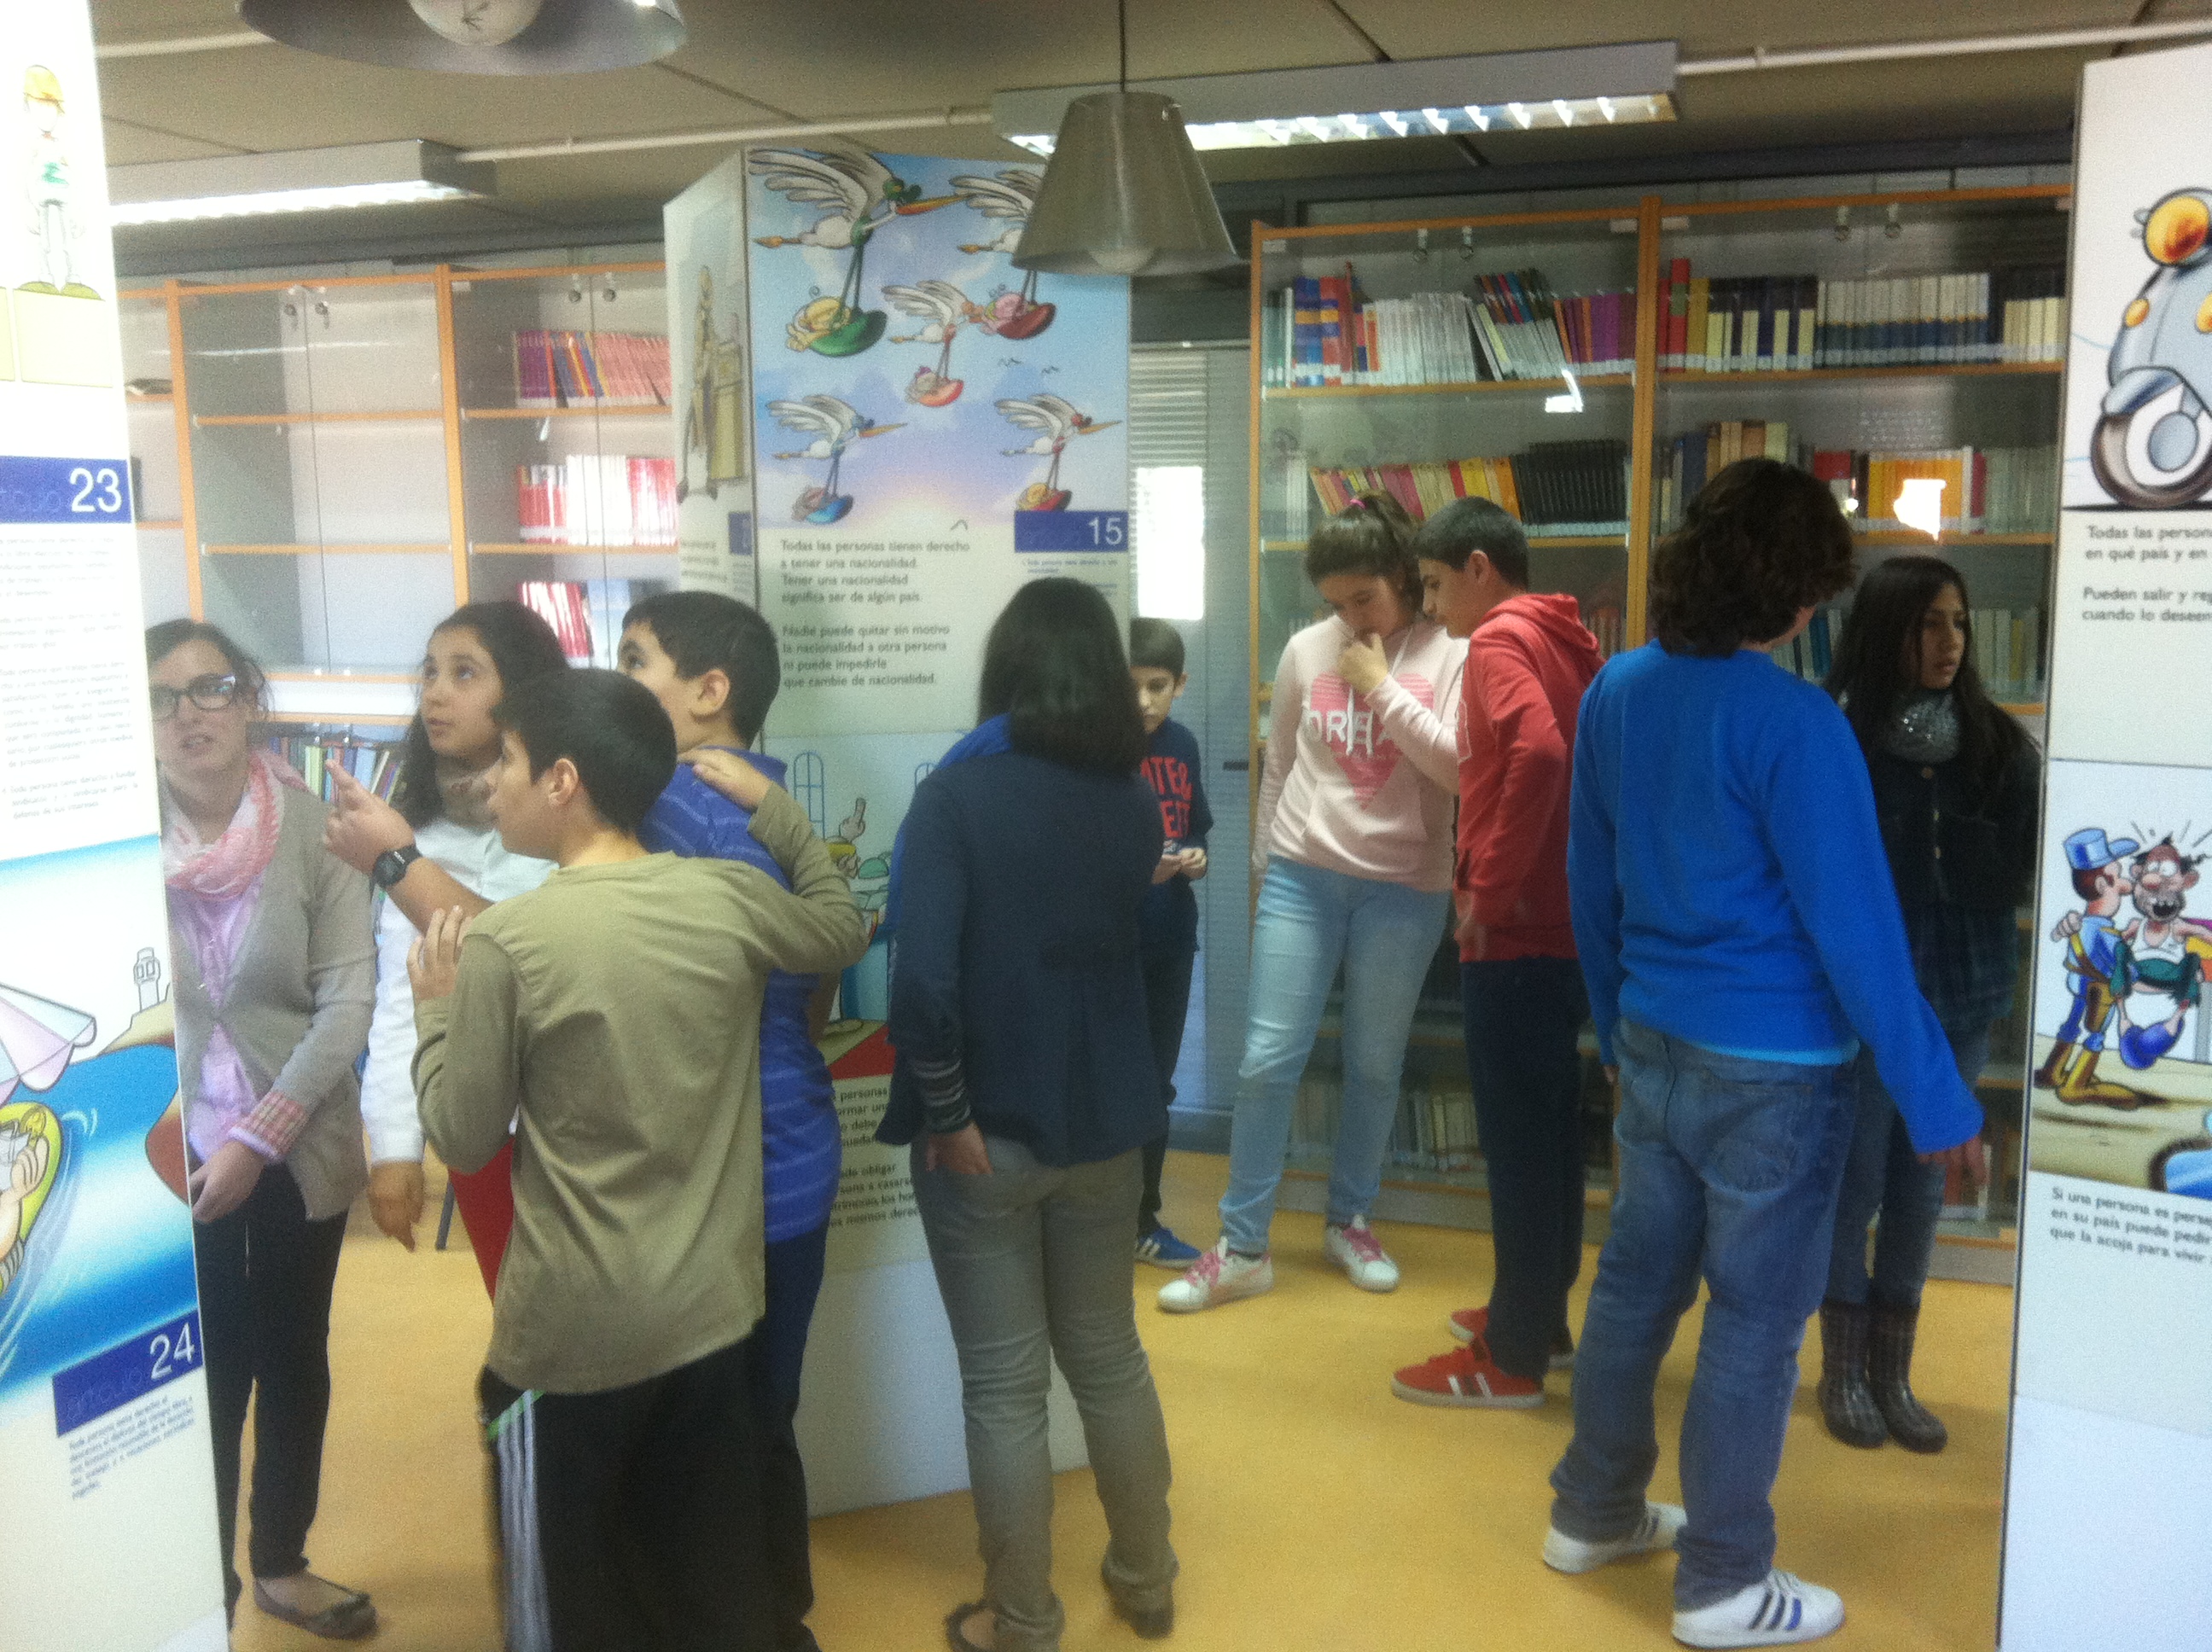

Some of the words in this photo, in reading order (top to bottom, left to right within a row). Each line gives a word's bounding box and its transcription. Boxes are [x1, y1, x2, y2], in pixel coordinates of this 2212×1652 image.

[70, 468, 122, 513] 23
[1088, 517, 1123, 545] 15
[2086, 525, 2128, 538] Todas
[2134, 526, 2152, 538] las
[780, 539, 812, 551] Todas
[835, 542, 884, 554] personas
[925, 540, 970, 552] derecho
[2085, 550, 2103, 560] en
[2173, 550, 2184, 563] y
[2187, 550, 2208, 560] en
[2083, 586, 2138, 601] Pueden
[2143, 588, 2173, 601] salir
[2177, 591, 2187, 605] y
[2081, 607, 2136, 621] cuando
[2140, 608, 2155, 621] lo
[904, 641, 946, 654] persona
[150, 1323, 195, 1381] 24
